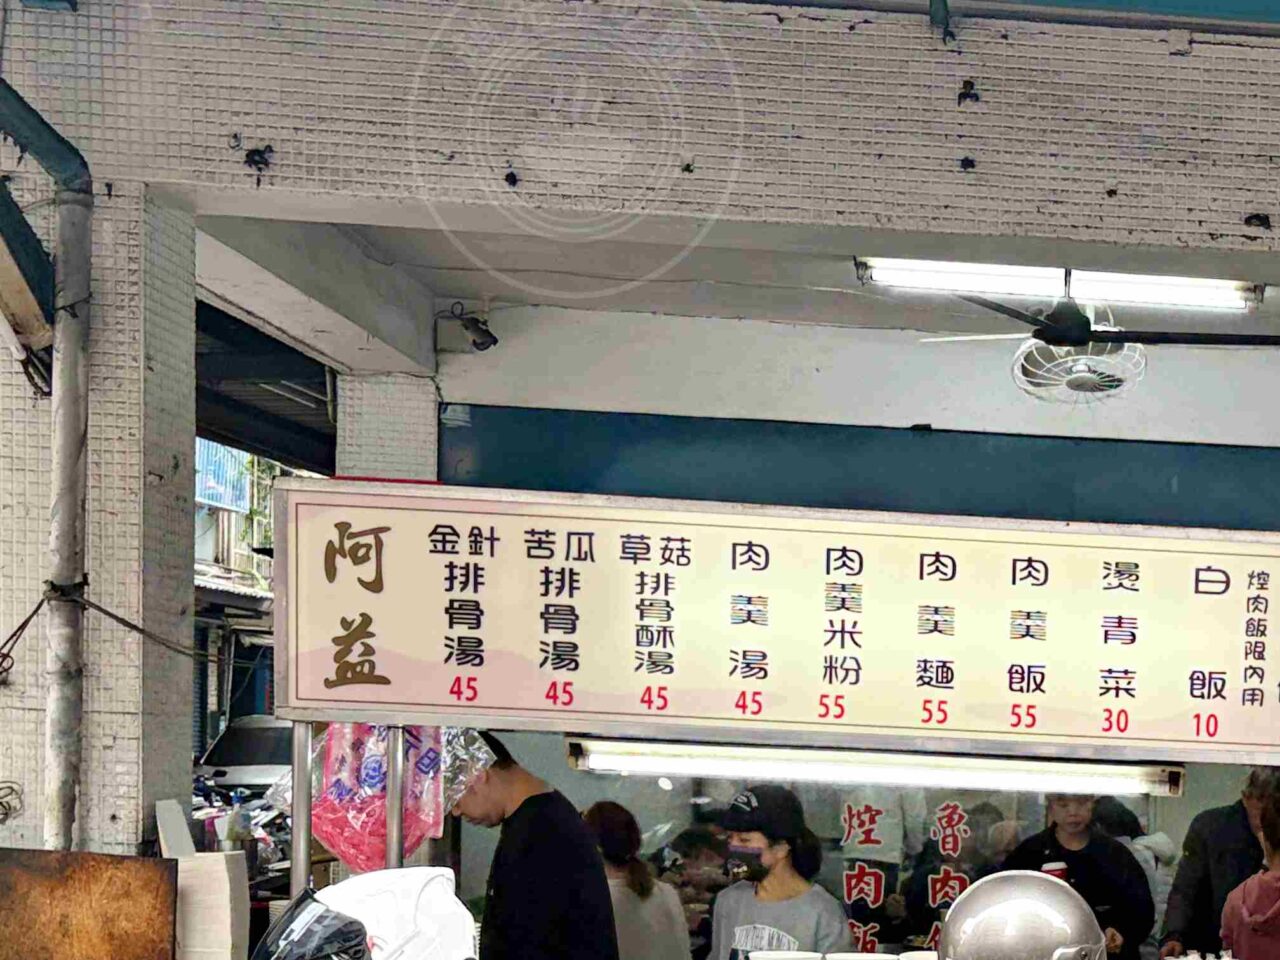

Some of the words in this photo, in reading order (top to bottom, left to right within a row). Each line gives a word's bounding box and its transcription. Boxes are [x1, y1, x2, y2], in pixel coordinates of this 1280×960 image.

[428, 524, 501, 558] 金針
[523, 528, 596, 563] 苦瓜
[619, 533, 692, 567] 草菇
[323, 521, 392, 690] 阿益
[443, 561, 486, 668] 排骨湯
[539, 566, 581, 672] 排骨湯
[634, 571, 676, 675] 排骨酥湯
[729, 541, 770, 680] 肉羹湯
[823, 545, 864, 685] 肉羹米粉
[916, 551, 957, 690] 肉羹麵
[1007, 556, 1049, 694] 肉羹飯
[1099, 560, 1140, 698] 燙青菜
[1188, 566, 1231, 700] 白飯
[449, 675, 479, 702] 45
[544, 680, 574, 707] 45
[639, 685, 669, 711] 45
[734, 690, 763, 716] 45
[818, 694, 846, 719] 55
[921, 699, 949, 725] 55
[1010, 703, 1037, 729] 55
[1101, 708, 1130, 734] 30
[1193, 712, 1219, 738] 10
[926, 801, 971, 952] 魯肉
